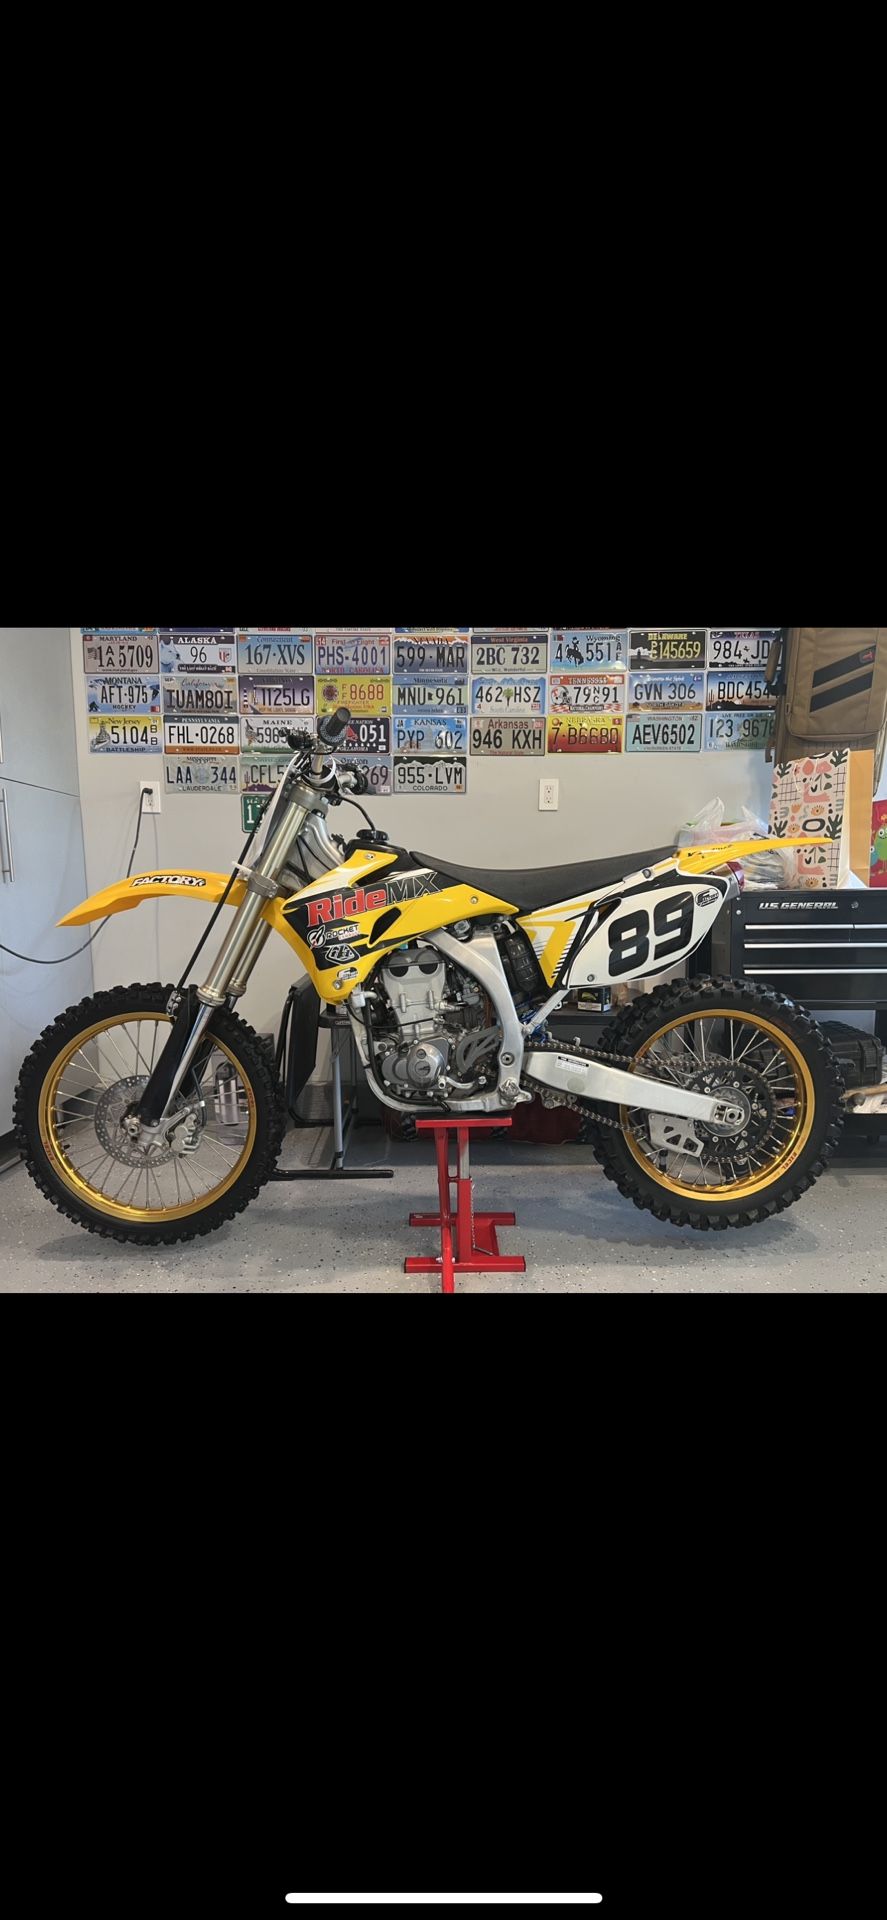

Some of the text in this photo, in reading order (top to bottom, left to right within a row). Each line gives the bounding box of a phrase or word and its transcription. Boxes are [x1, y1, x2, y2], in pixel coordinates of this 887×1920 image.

[586, 635, 616, 643] Wyoming
[190, 646, 207, 663] 96
[476, 646, 539, 665] 2BC 732
[555, 642, 611, 662] 4 551
[713, 640, 770, 660] 984 JD
[398, 687, 464, 706] MNU 961
[475, 686, 541, 703] 462 HSZ
[634, 683, 696, 700] GVN 306
[718, 681, 778, 700] BDC454
[488, 719, 529, 729] Arkansas
[710, 719, 733, 738] 123
[111, 726, 149, 745] 5104
[360, 725, 386, 742] 051
[397, 730, 463, 749] PYP 602
[473, 729, 542, 749] 946 KXH
[632, 724, 695, 745] AEV6502
[166, 766, 237, 784] LAA 344
[250, 765, 289, 783] CFL5
[131, 875, 203, 887] FACTORY
[780, 902, 838, 910] GENERAL
[326, 924, 359, 940] ROCKET
[608, 891, 694, 977] 89
